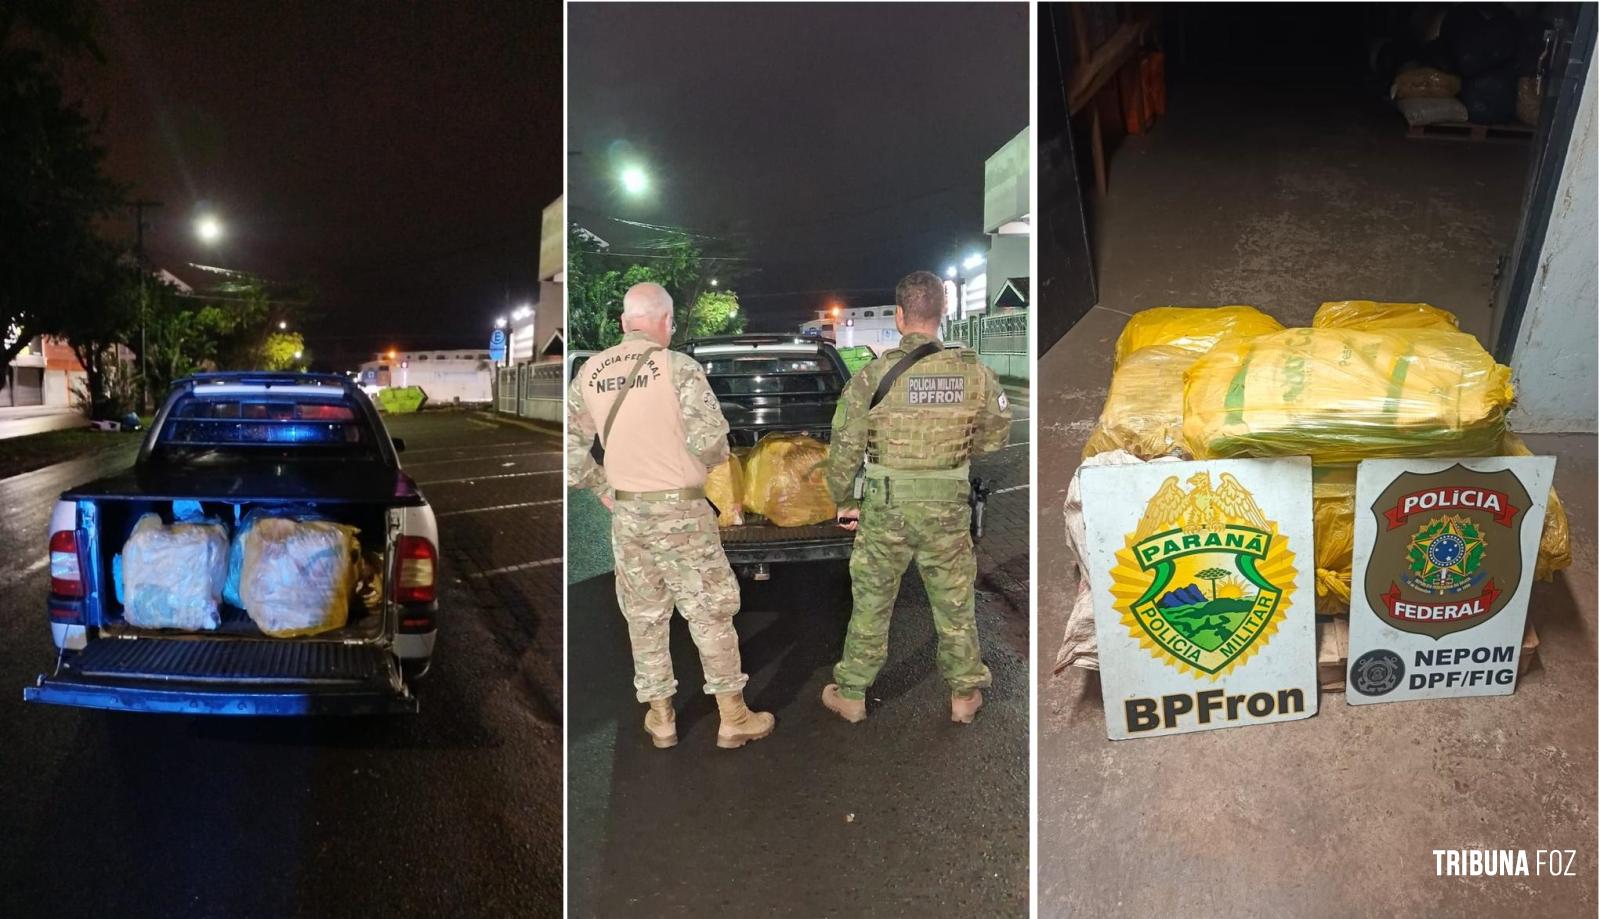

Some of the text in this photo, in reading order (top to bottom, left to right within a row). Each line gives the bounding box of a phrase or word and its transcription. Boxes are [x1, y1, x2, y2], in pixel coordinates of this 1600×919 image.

[937, 377, 964, 391] MILITAR
[909, 390, 964, 404] BPFRON
[1403, 490, 1501, 514] POLÍCIA
[1141, 532, 1262, 562] PARANÁ
[1394, 600, 1485, 620] FEDERAL
[1141, 595, 1273, 663] POLÍCIA MILITAR
[1414, 646, 1515, 667] NEPOM
[1408, 668, 1514, 691] DPF/FIG
[1124, 687, 1305, 734] BPFron
